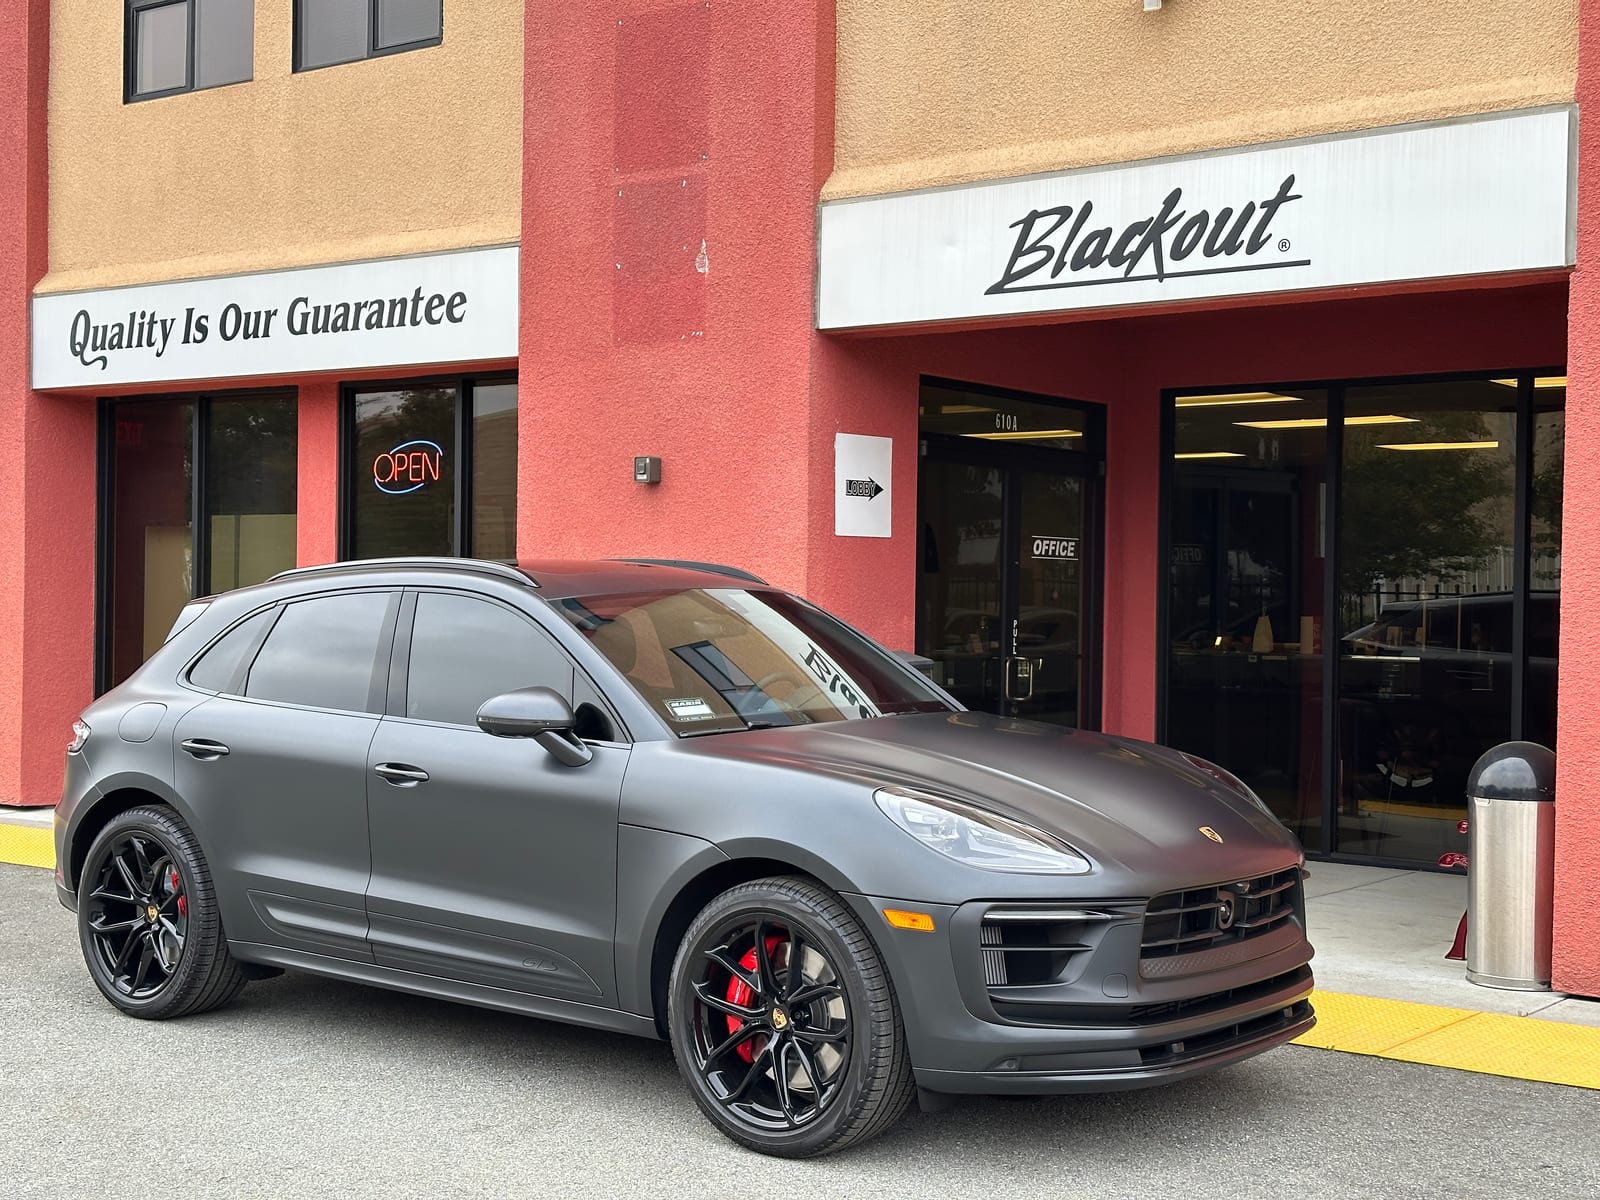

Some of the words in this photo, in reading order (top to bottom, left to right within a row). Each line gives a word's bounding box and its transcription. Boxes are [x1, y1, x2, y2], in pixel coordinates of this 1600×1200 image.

[984, 174, 1303, 294] Blackout
[69, 308, 176, 370] Quality
[181, 306, 209, 345] Is
[218, 302, 277, 342] Our
[287, 286, 467, 336] Guarantee
[995, 413, 1018, 431] 610A
[373, 452, 440, 483] OPEN
[846, 480, 877, 496] LOBBY
[1032, 539, 1076, 557] OFFICE
